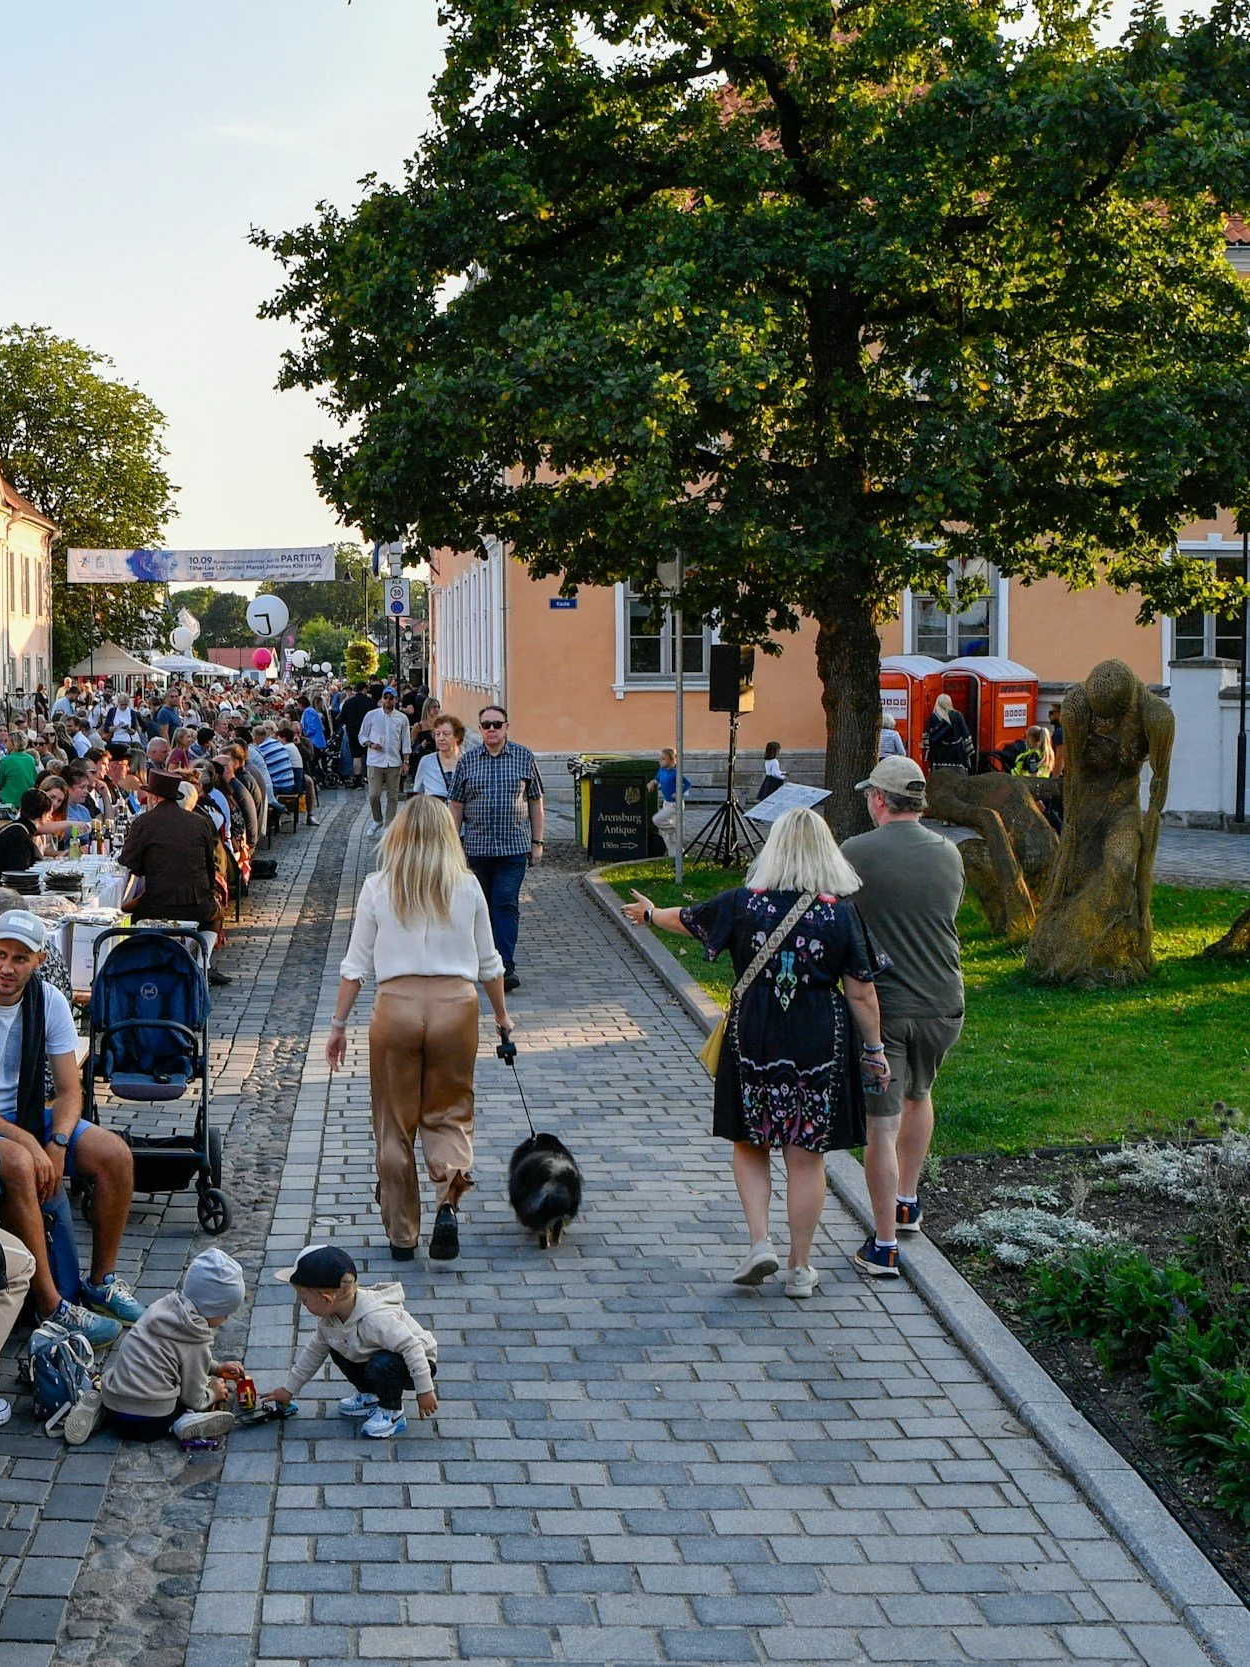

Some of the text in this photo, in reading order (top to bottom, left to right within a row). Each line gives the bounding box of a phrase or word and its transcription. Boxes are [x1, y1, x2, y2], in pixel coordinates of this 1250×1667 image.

[188, 556, 213, 565] 10.09
[280, 554, 322, 562] PARTIITA
[254, 613, 272, 635] J
[598, 812, 642, 824] Arensburg
[603, 825, 637, 836] Antique
[602, 841, 619, 849] 150m
